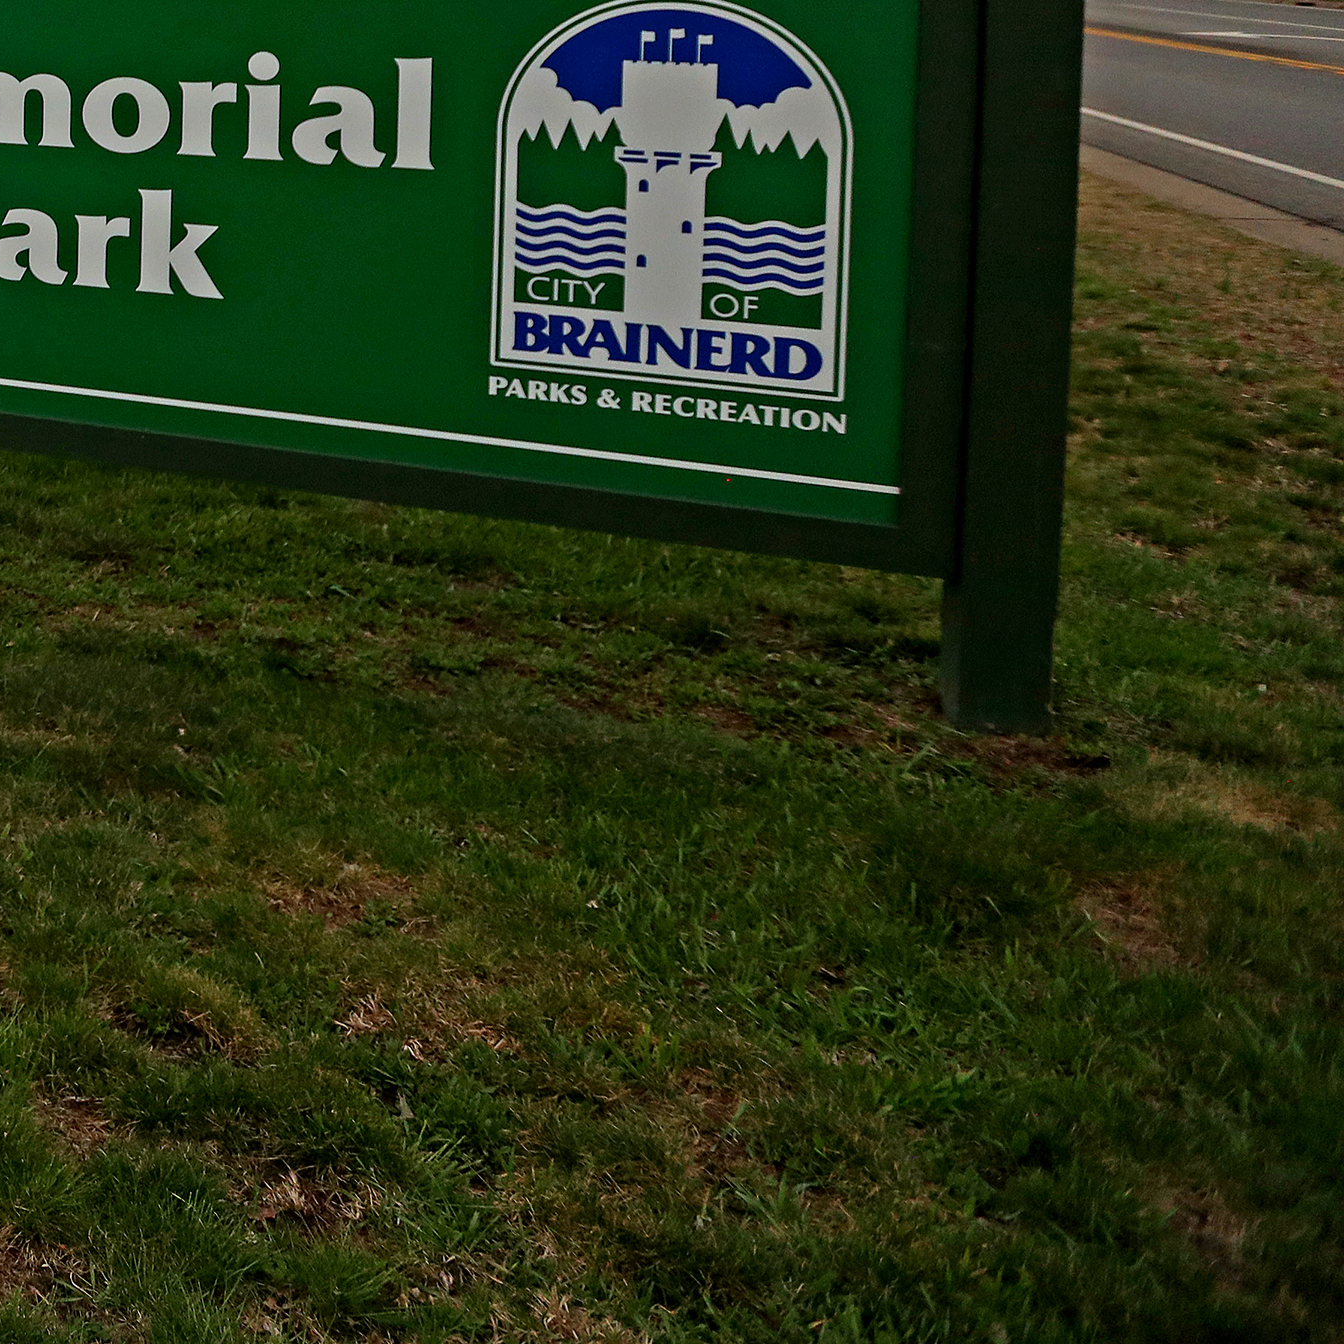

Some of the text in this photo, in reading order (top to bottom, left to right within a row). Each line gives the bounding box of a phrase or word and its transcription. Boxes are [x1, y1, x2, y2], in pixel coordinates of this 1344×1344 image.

[526, 275, 760, 320] CITY OF
[512, 311, 823, 381] BRAINERD
[487, 374, 848, 435] PARKS & RECREATION
